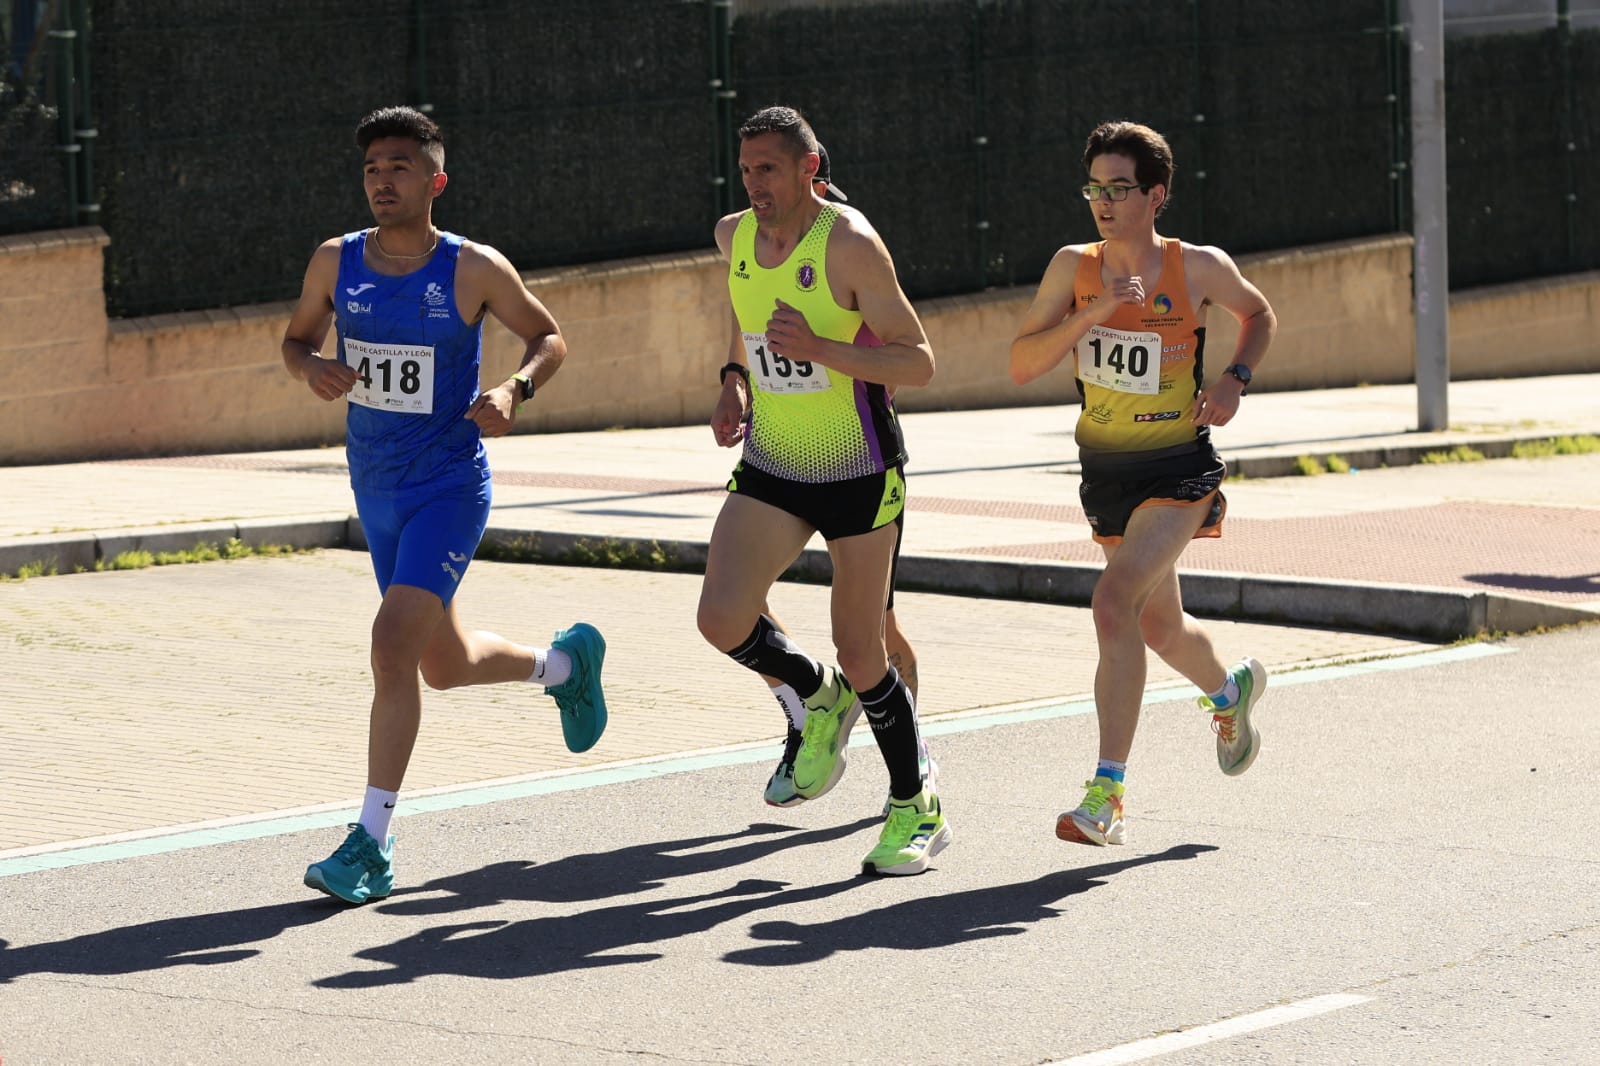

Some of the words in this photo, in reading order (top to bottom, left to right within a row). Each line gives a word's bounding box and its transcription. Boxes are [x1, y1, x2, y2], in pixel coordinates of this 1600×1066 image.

[1101, 330, 1131, 342] CASTILLA
[348, 343, 359, 351] DÍA
[360, 345, 368, 353] DE
[369, 348, 403, 356] CASTILLA
[411, 349, 432, 357] LEÓN
[1162, 342, 1187, 353] QUEZ
[1089, 338, 1149, 377] 140
[1162, 353, 1188, 362] NTAL
[358, 357, 420, 394] 418
